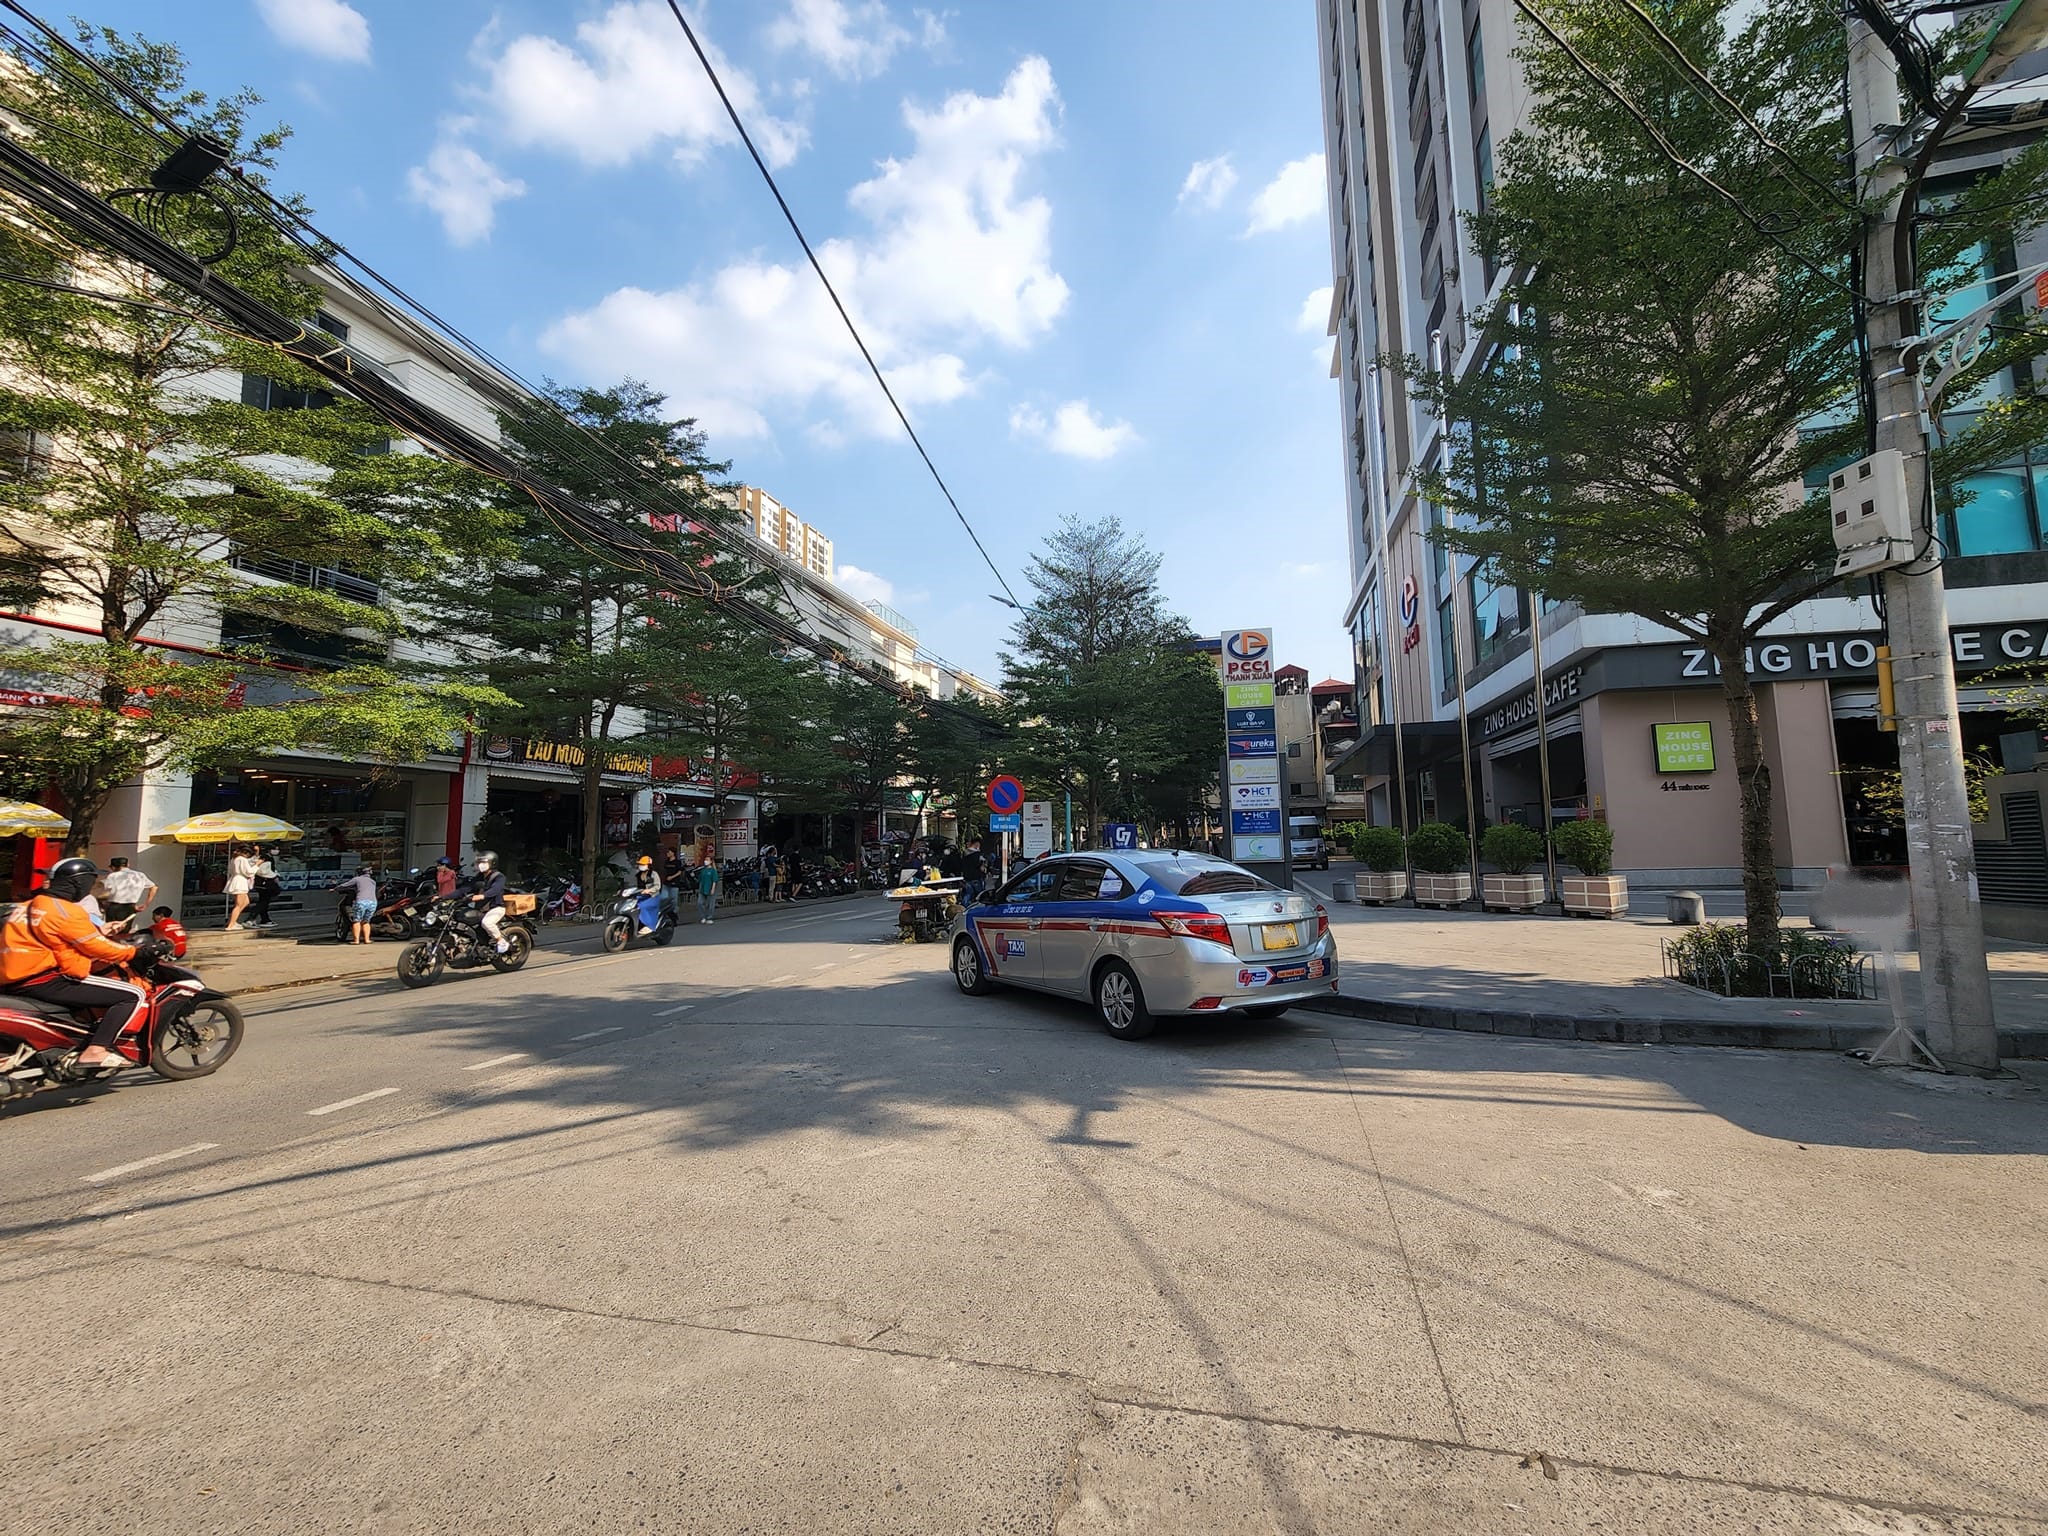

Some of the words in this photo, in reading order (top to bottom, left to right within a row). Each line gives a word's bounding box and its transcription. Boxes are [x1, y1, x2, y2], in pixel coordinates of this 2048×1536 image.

[1808, 631, 1984, 671] HOE
[2000, 628, 2048, 659] C
[1228, 660, 1270, 674] PCC1
[1225, 673, 1250, 682] THANH
[1484, 708, 1505, 735] ZING
[1543, 669, 1577, 706] CAFE
[1665, 730, 1702, 741] ZING
[1660, 742, 1710, 752] HOUSE
[1667, 754, 1705, 764] CAFE
[1251, 787, 1272, 796] HCT
[1660, 780, 1678, 792] 44
[1253, 811, 1270, 819] HCT
[1116, 827, 1132, 846] G7
[1008, 941, 1025, 952] TAXI
[1238, 968, 1253, 987] G7
